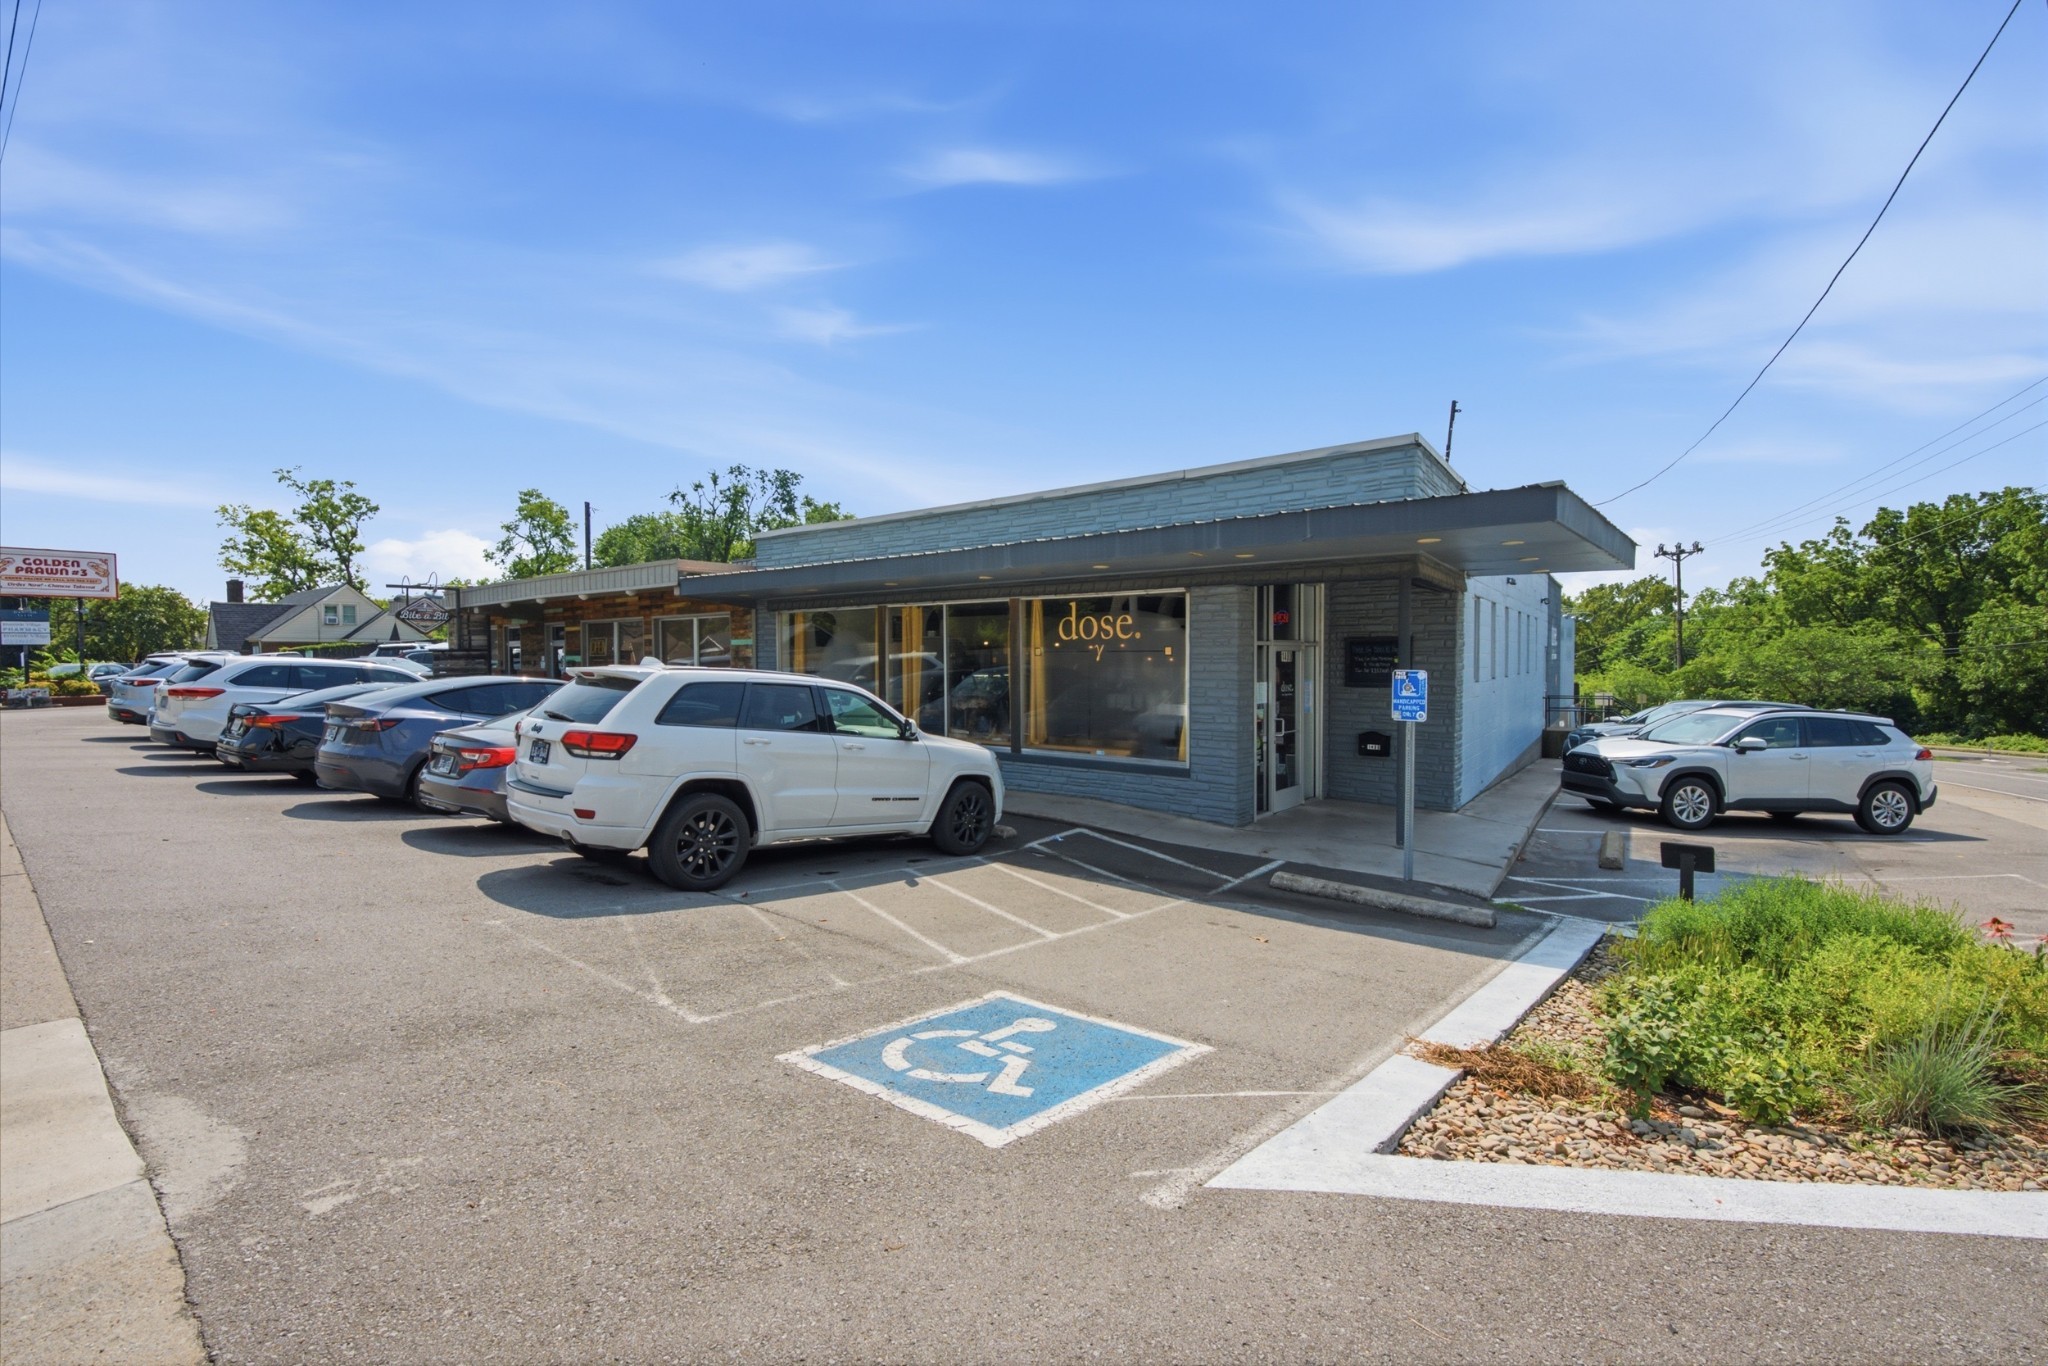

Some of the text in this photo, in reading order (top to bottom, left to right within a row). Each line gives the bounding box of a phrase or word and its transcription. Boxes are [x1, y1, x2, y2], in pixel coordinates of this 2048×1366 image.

[22, 557, 81, 568] GOLDEN
[15, 566, 88, 577] PRAWN #3
[1059, 601, 1141, 640] dose.
